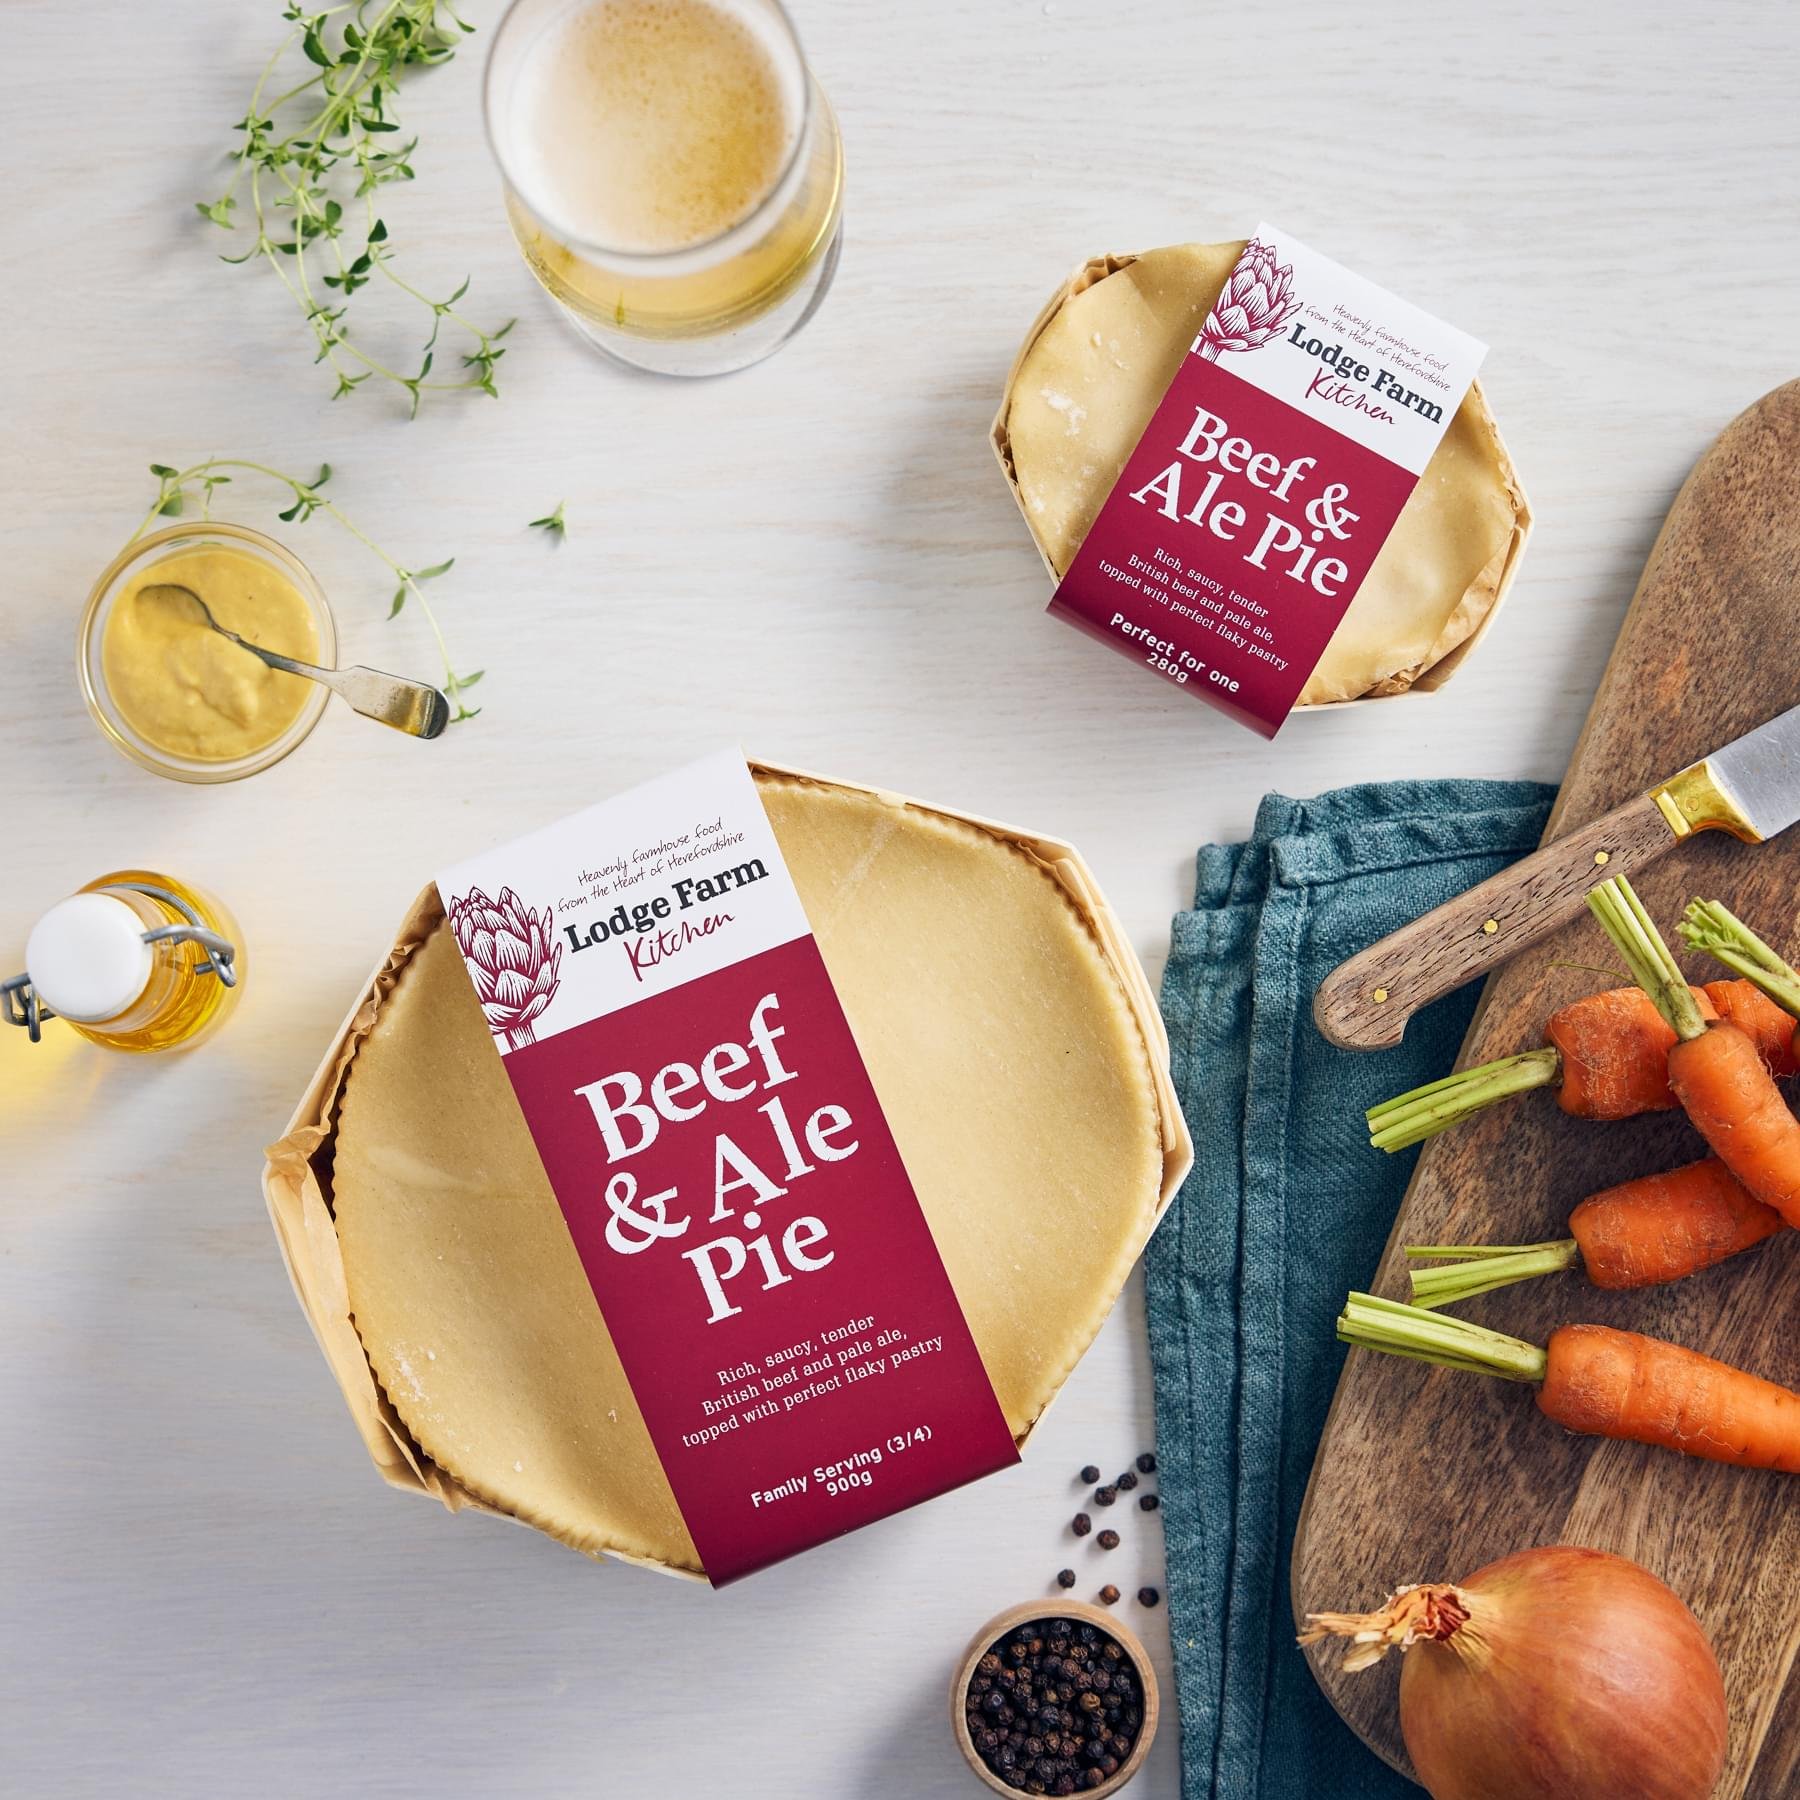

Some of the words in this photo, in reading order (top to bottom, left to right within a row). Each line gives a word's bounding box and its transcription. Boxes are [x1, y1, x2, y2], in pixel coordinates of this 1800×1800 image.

[1287, 323, 1369, 382] Lodge
[1371, 369, 1443, 424] Farm
[1305, 306, 1328, 325] from
[1332, 320, 1346, 334] the
[1348, 330, 1376, 348] Heart
[1376, 348, 1392, 356] of
[1390, 353, 1450, 391] Herefordshire
[1333, 305, 1371, 333] Heavenly
[1375, 327, 1420, 357] farmhouse
[1424, 354, 1448, 372] food
[1305, 367, 1395, 424] Kitchen
[1176, 406, 1317, 503] Beef
[1306, 484, 1360, 540] &
[1129, 461, 1246, 540] Ale
[1243, 513, 1348, 596] Pie
[1100, 560, 1141, 588] topped
[1144, 585, 1168, 604] with
[1170, 601, 1214, 629] perfect
[1216, 624, 1247, 648] flaky
[1248, 644, 1288, 670] pastry
[1128, 554, 1168, 584] British
[1172, 578, 1199, 600] beef
[1200, 597, 1224, 613] and
[1224, 610, 1251, 629] pale
[1254, 627, 1273, 644] ale,
[1154, 548, 1182, 573] Rich,
[1188, 569, 1223, 596] saucy,
[1229, 590, 1268, 617] tender
[1111, 613, 1174, 656] Perfect
[1179, 651, 1205, 672] for
[1210, 671, 1239, 692] one
[1147, 652, 1188, 683] 280g
[558, 896, 587, 912] from
[591, 884, 609, 899] the
[613, 866, 646, 892] Heart
[651, 859, 664, 876] of
[668, 833, 744, 870] Herefordshire
[578, 856, 628, 886] Heavenly
[632, 835, 690, 863] farmhouse
[695, 817, 722, 838] food
[563, 897, 671, 953] Lodge
[671, 859, 769, 910] Farm
[623, 914, 735, 982] Kitchen
[574, 993, 798, 1164] Beef
[605, 1172, 691, 1254] &
[709, 1098, 858, 1223] Ale
[682, 1212, 834, 1324] Pie
[683, 1415, 739, 1446] topped
[742, 1400, 779, 1423] with
[783, 1376, 841, 1411] perfect
[845, 1359, 884, 1383] flaky
[890, 1337, 941, 1368] pastry
[702, 1385, 760, 1415] British
[762, 1367, 799, 1391] beef
[803, 1354, 833, 1376] and
[837, 1342, 872, 1365] pale
[877, 1330, 906, 1346] ale,
[717, 1362, 760, 1385] Rich,
[766, 1341, 817, 1367] saucy,
[821, 1316, 873, 1344] tender
[751, 1476, 806, 1507] Family
[814, 1448, 882, 1483] Serving
[887, 1426, 931, 1453] (3/4)
[827, 1471, 872, 1496] 900g
